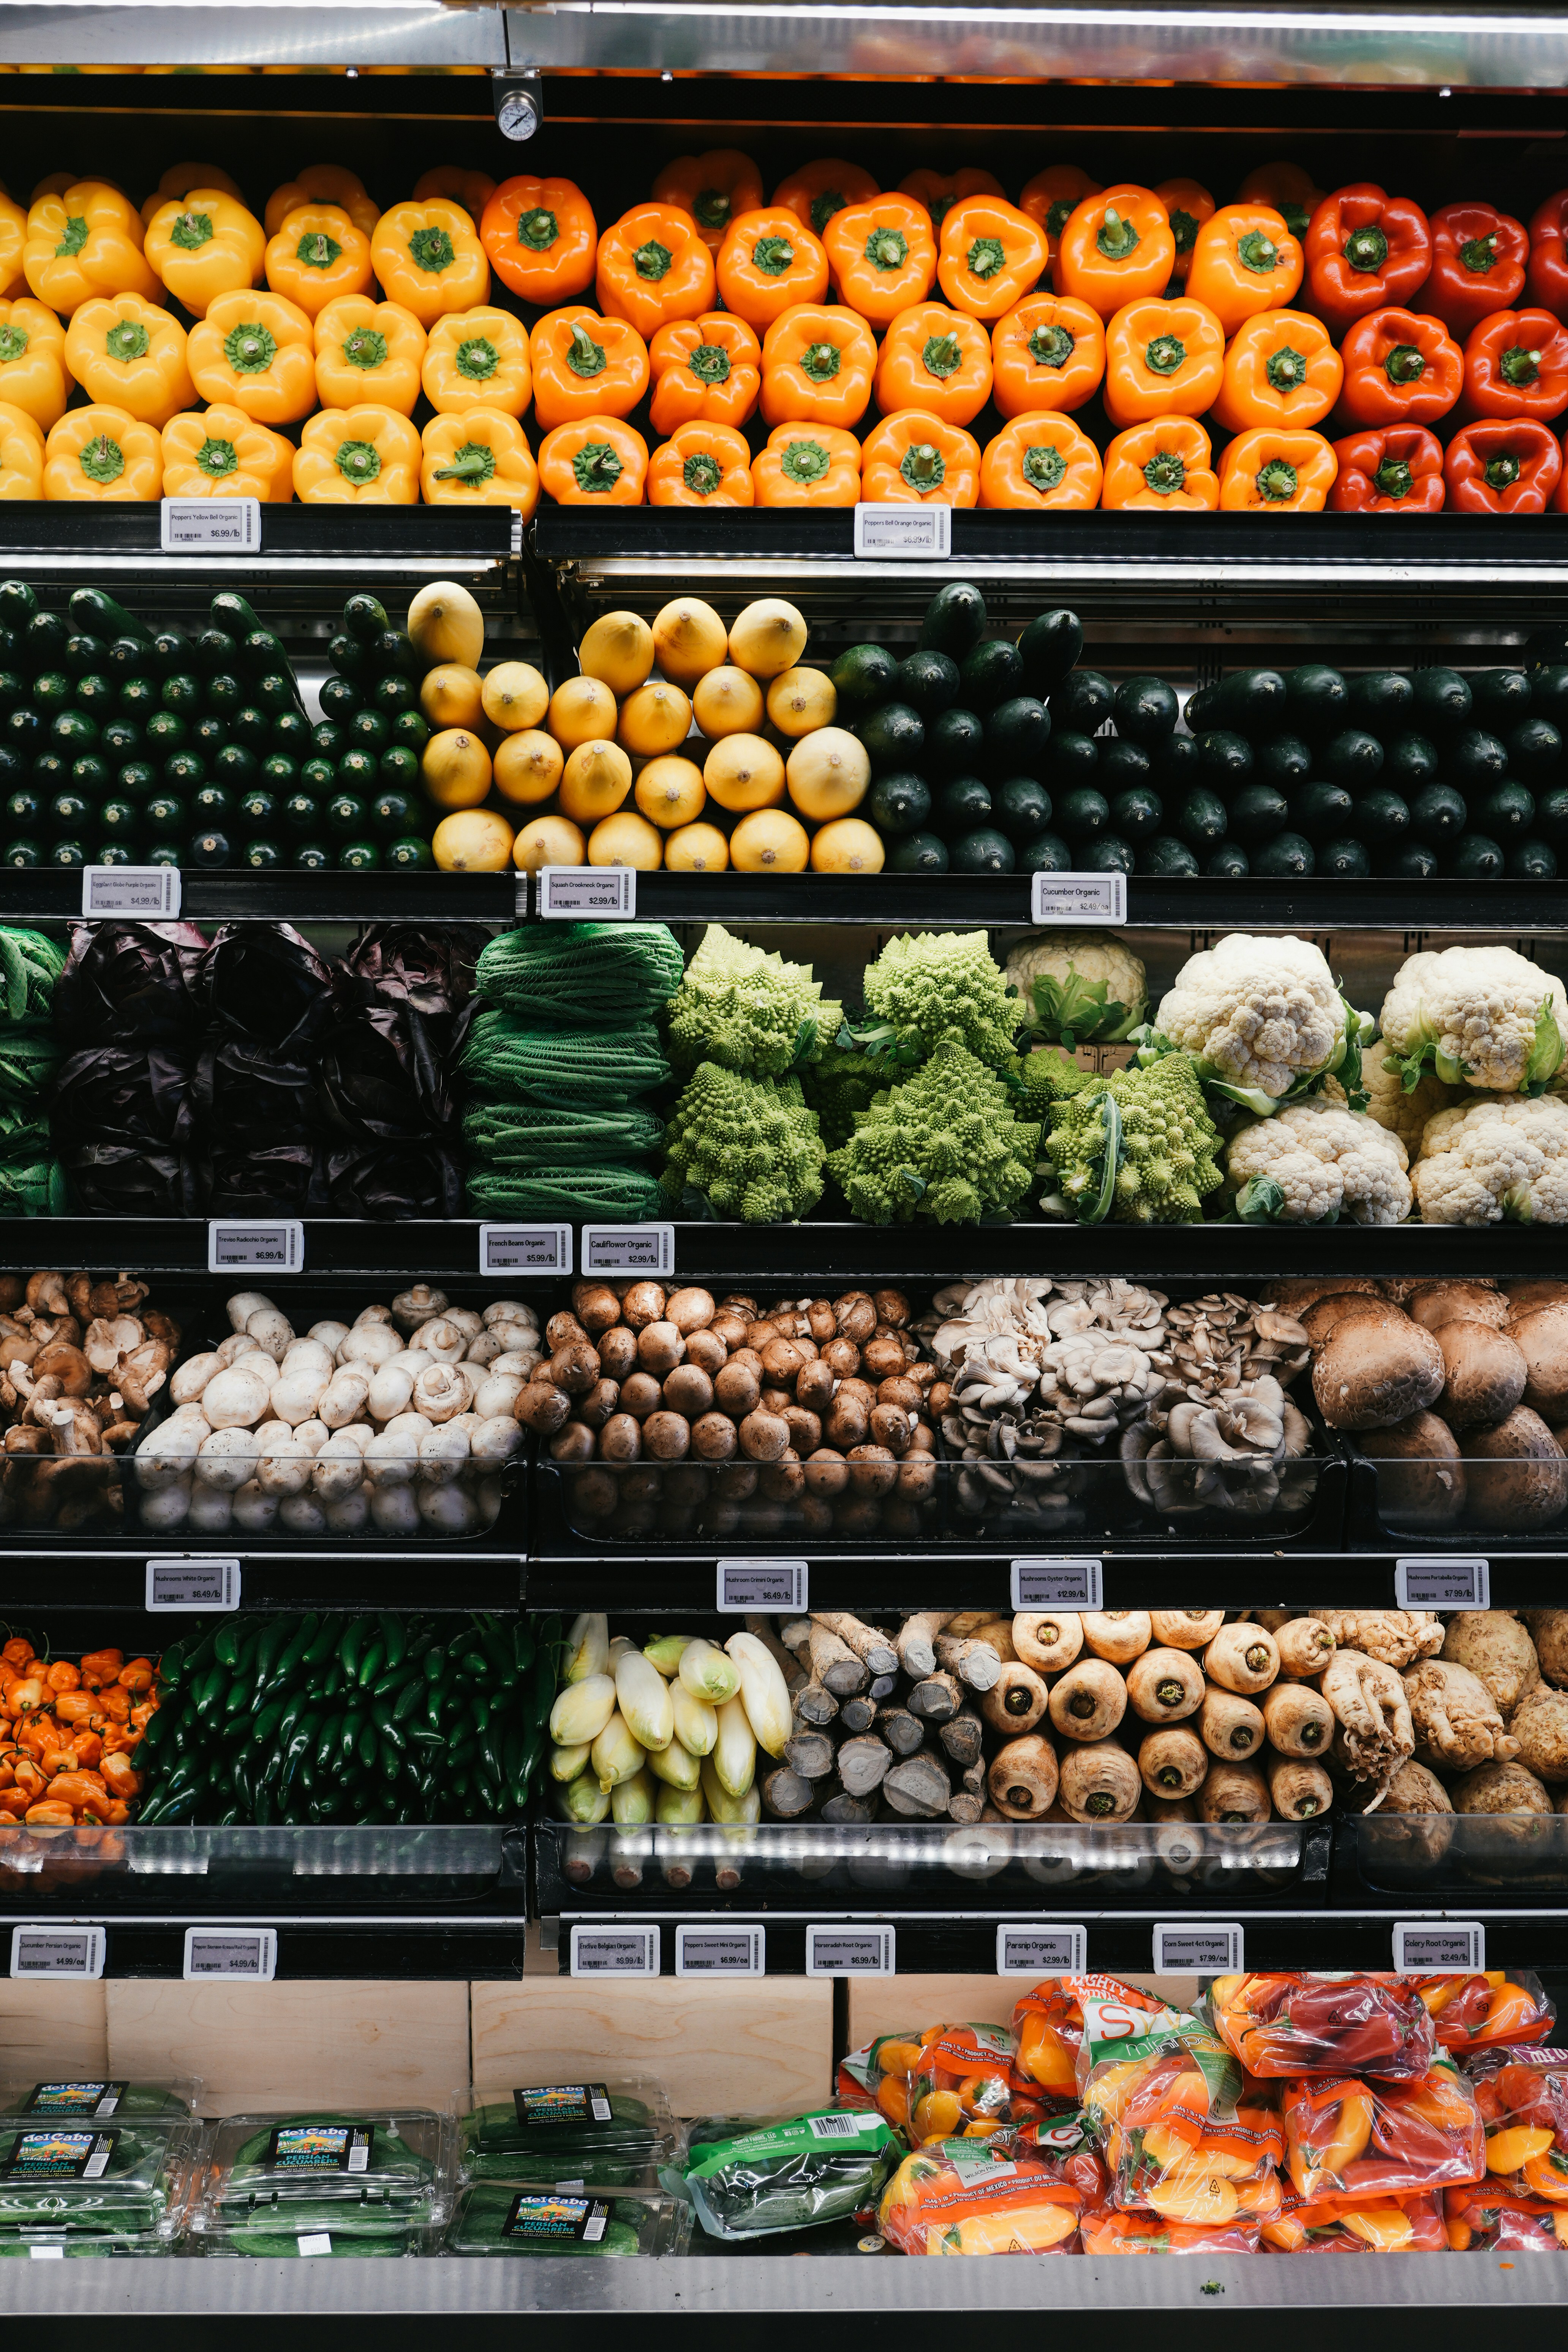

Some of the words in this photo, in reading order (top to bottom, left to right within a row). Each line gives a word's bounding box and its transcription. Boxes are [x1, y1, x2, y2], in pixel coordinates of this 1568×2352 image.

[628, 1241, 652, 1249] Organic
[1007, 1942, 1031, 1951] Parsnip
[1032, 1942, 1056, 1951] Organic
[1069, 1974, 1129, 1997] MIGHTY
[1078, 1987, 1120, 2003] MINIS
[1212, 2112, 1233, 2121] PRODUCE
[1232, 2127, 1253, 2137] PRODUIT
[1262, 2128, 1282, 2140] MEXIQUE
[965, 2169, 985, 2179] WILSON
[986, 2180, 1007, 2192] MEXICO
[1012, 2176, 1033, 2185] PRODUIT
